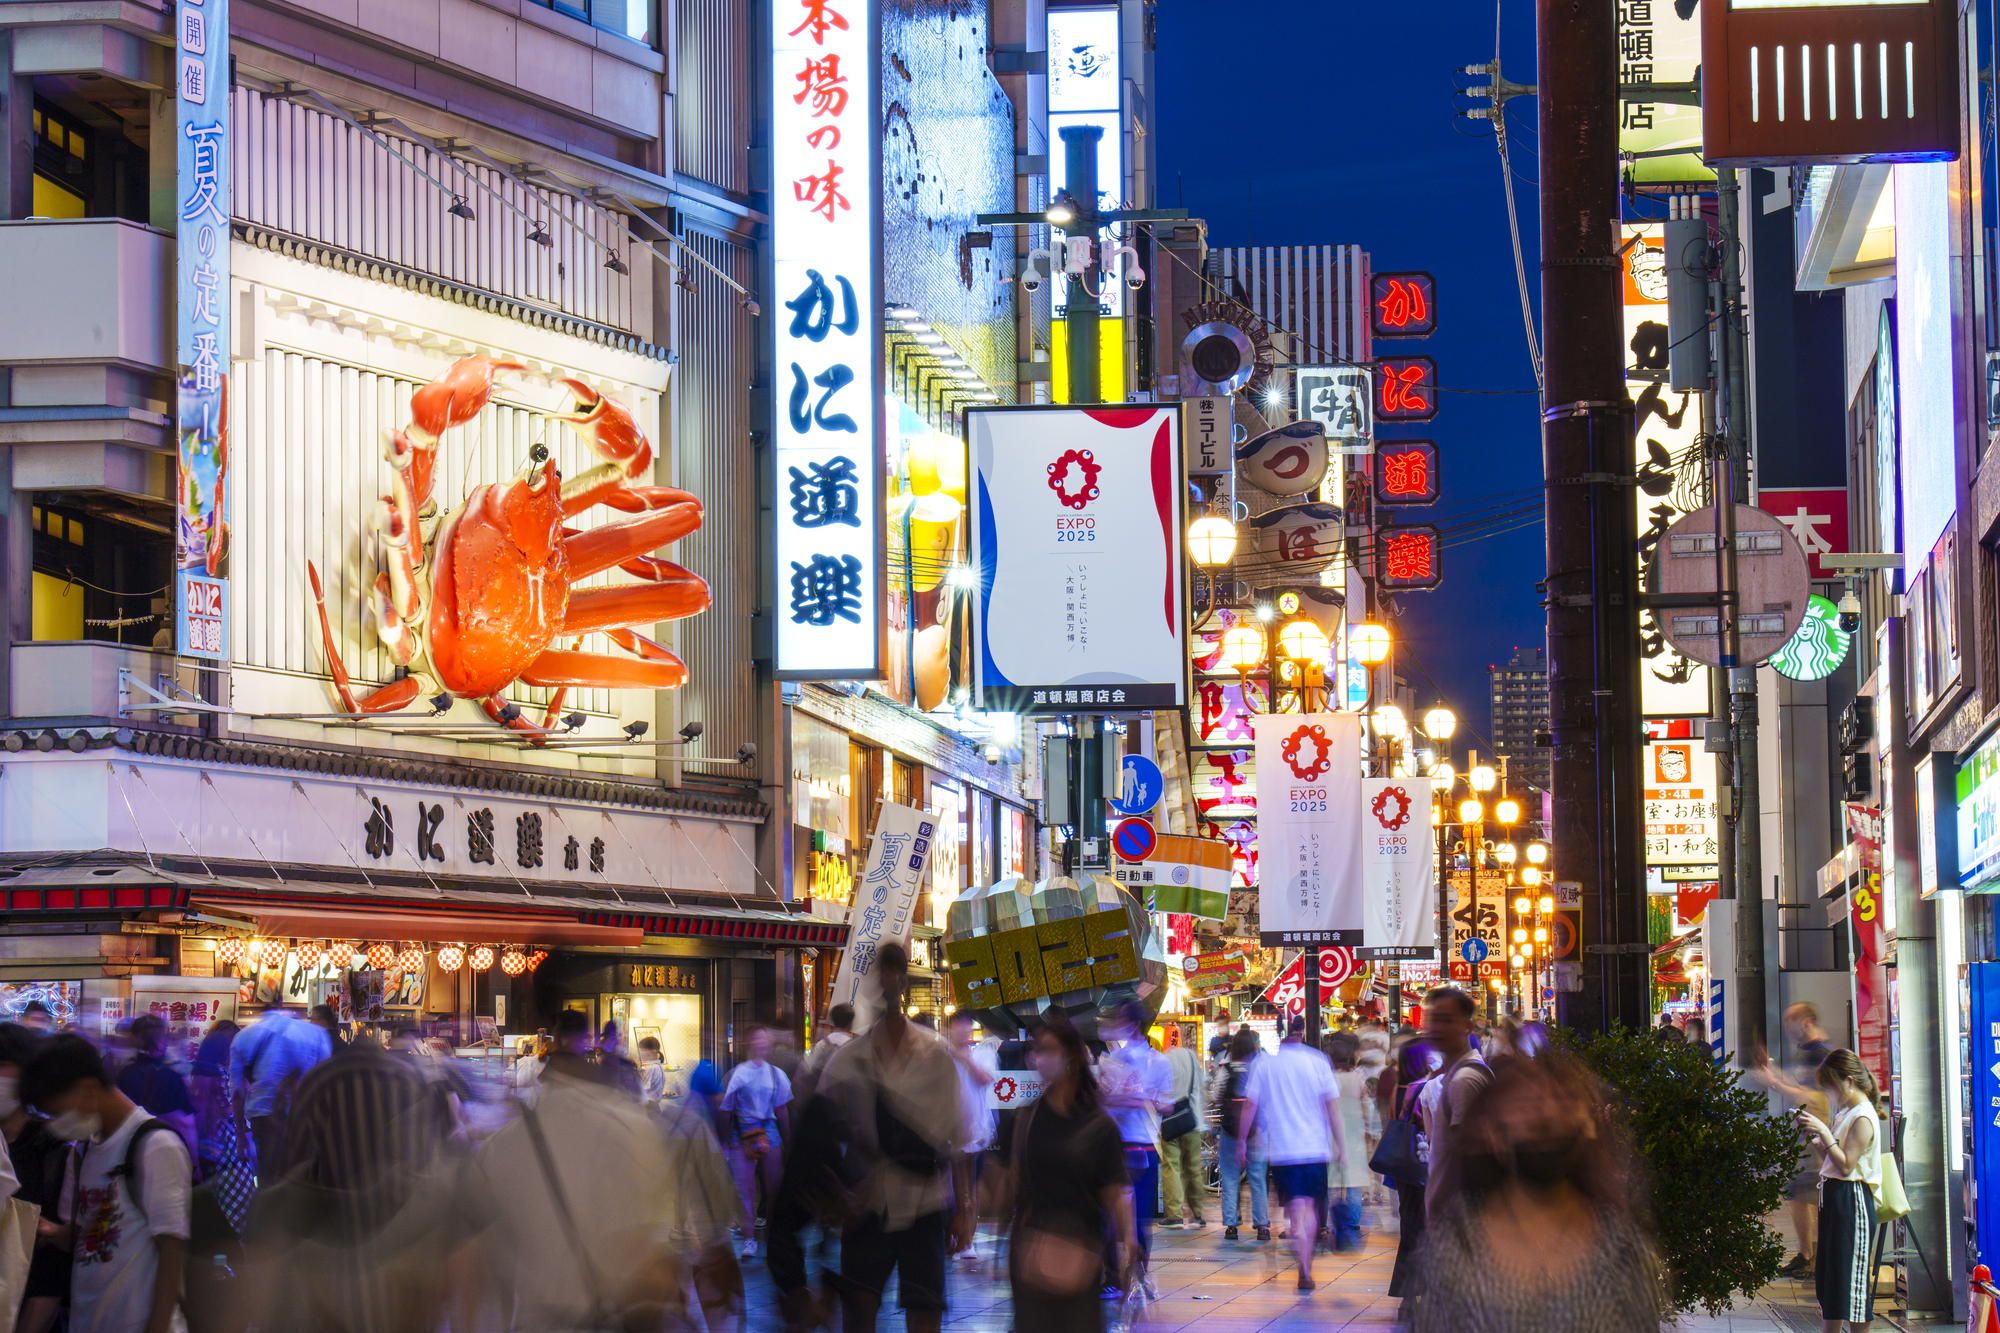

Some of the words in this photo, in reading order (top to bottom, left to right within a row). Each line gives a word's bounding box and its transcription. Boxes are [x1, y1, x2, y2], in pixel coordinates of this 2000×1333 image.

[787, 0, 851, 224] 本場の味
[1056, 517, 1096, 530] EXPO
[1057, 530, 1096, 542] 2025
[1033, 690, 1126, 704] 道頓堀商店会
[1290, 789, 1327, 800] EXPO
[1290, 801, 1327, 812] 2025
[1378, 837, 1407, 846] EXPO
[1379, 846, 1407, 855] 2025
[1116, 869, 1154, 882] 自動車
[1282, 932, 1341, 942] 道頓堀商店会
[1454, 929, 1500, 941] KURA
[1373, 947, 1417, 955] 道頓堀商店会
[1199, 955, 1223, 963] INDIAN
[1200, 957, 1243, 969] RESTAURANT
[1192, 975, 1229, 989] DINNER
[1232, 981, 1244, 990] 2F
